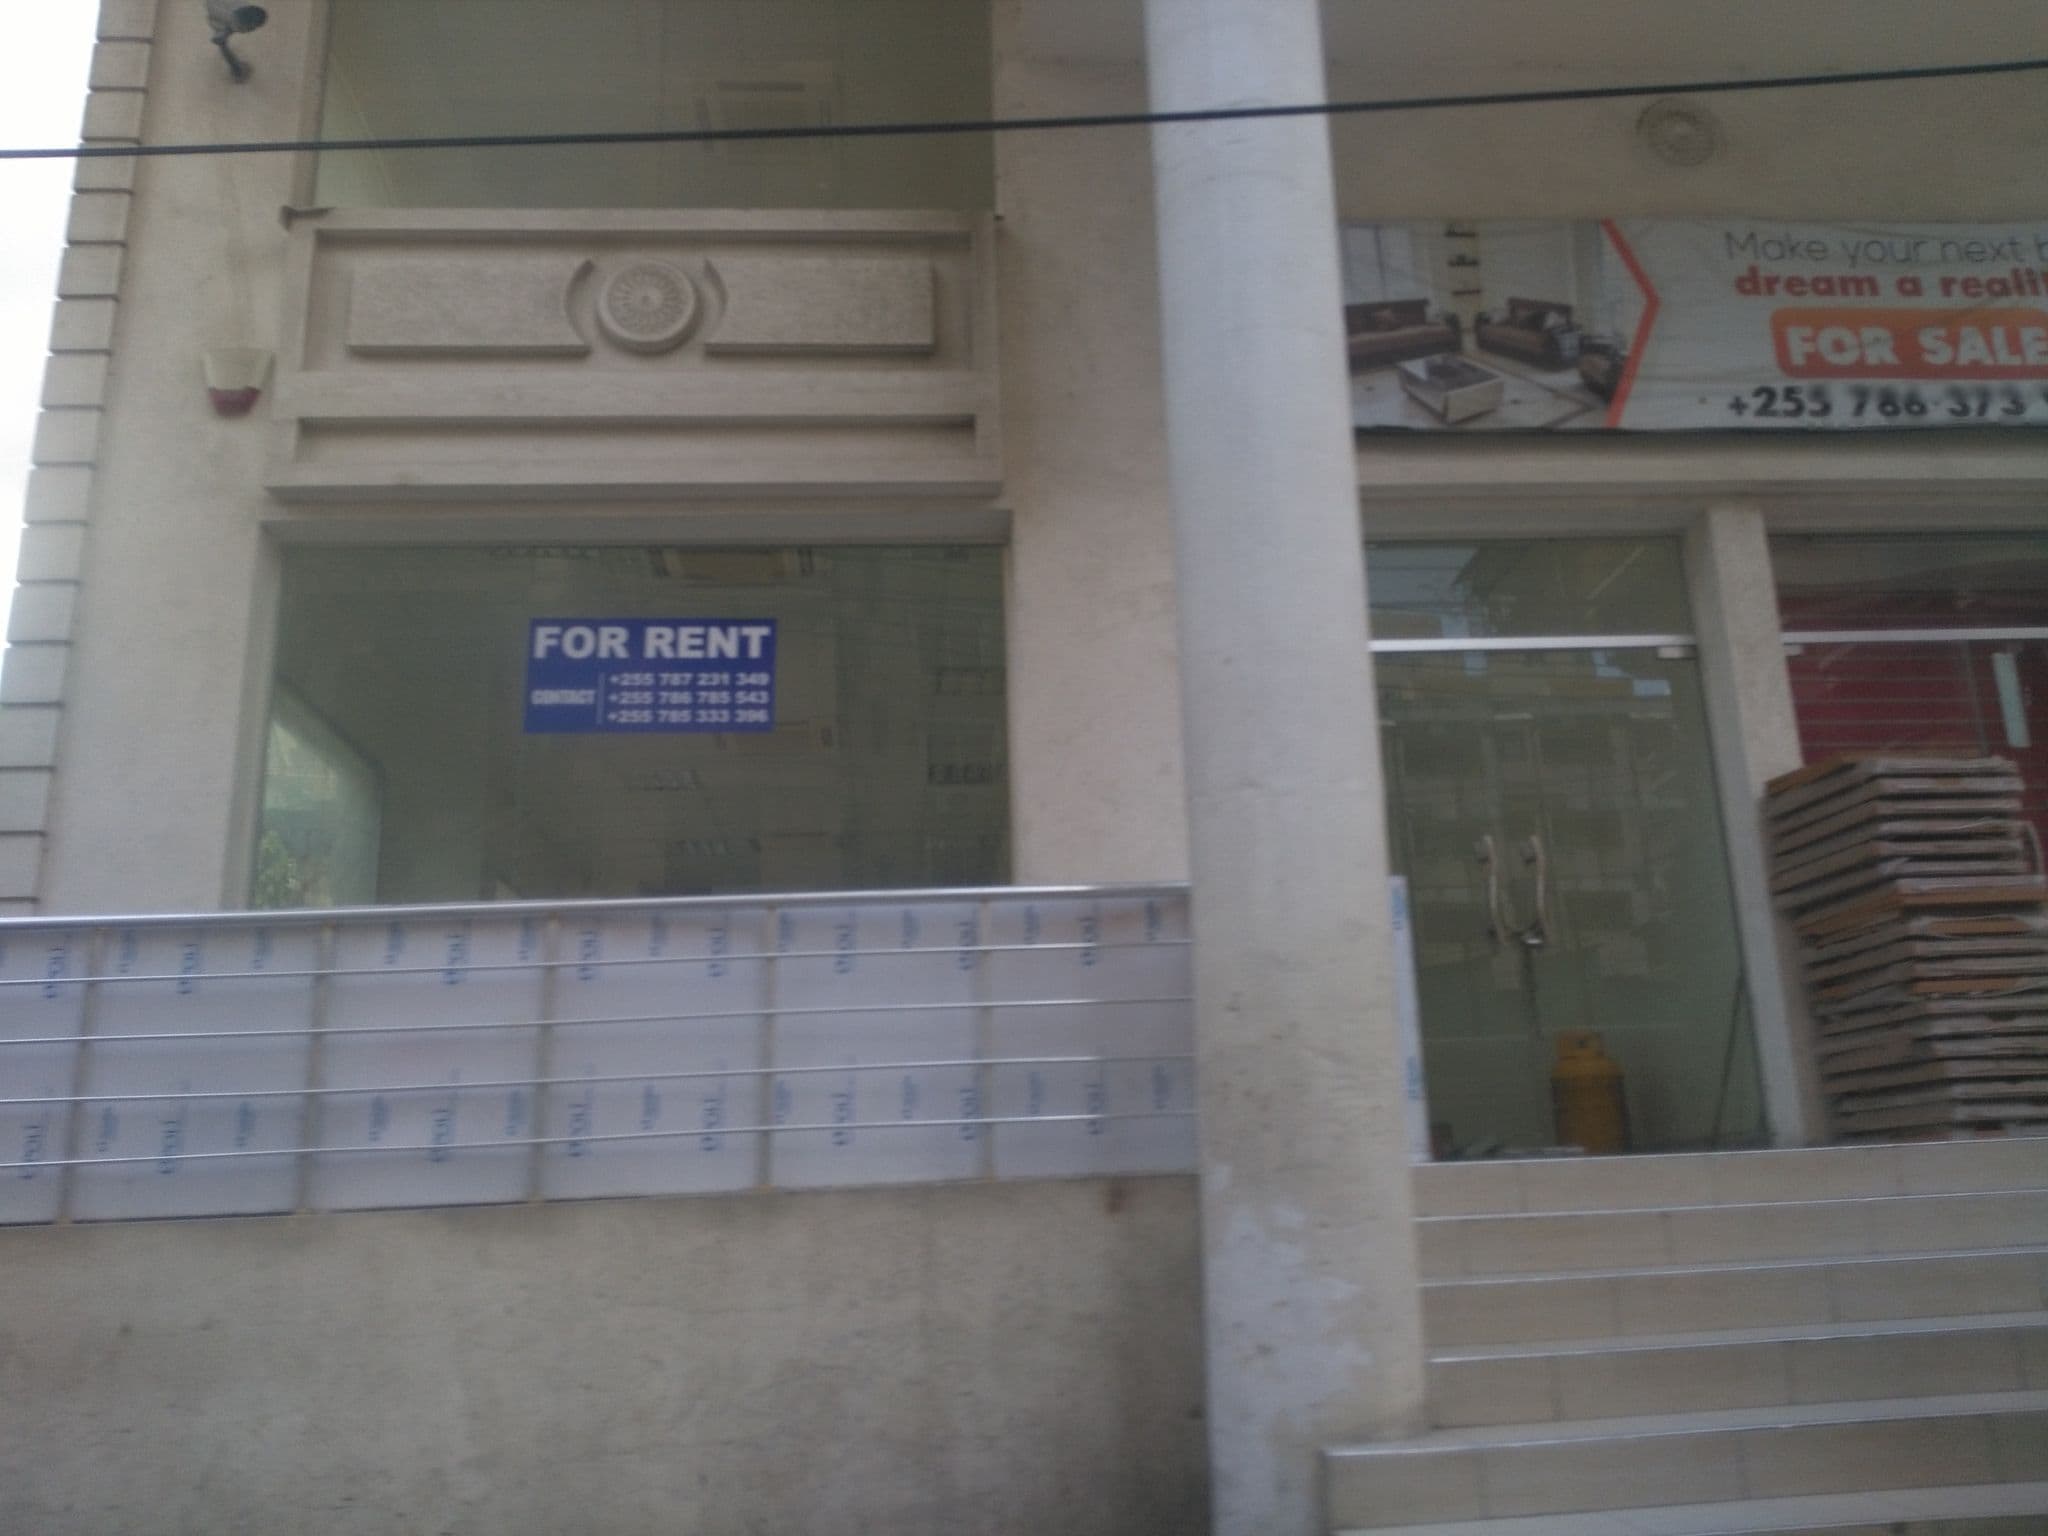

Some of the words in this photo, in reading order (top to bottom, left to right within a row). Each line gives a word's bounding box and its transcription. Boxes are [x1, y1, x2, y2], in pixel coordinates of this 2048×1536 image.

[1724, 231, 1829, 262] Make
[1841, 236, 1928, 268] your
[1940, 233, 2026, 263] next
[1734, 265, 1880, 298] dream
[1896, 274, 1923, 298] a
[1785, 326, 1902, 366] FOR
[1918, 326, 2048, 366] SALE
[1728, 386, 1832, 418] +255
[533, 626, 630, 659] FOR
[643, 626, 770, 659] RENT
[609, 672, 655, 687] +255
[608, 691, 654, 705] +255
